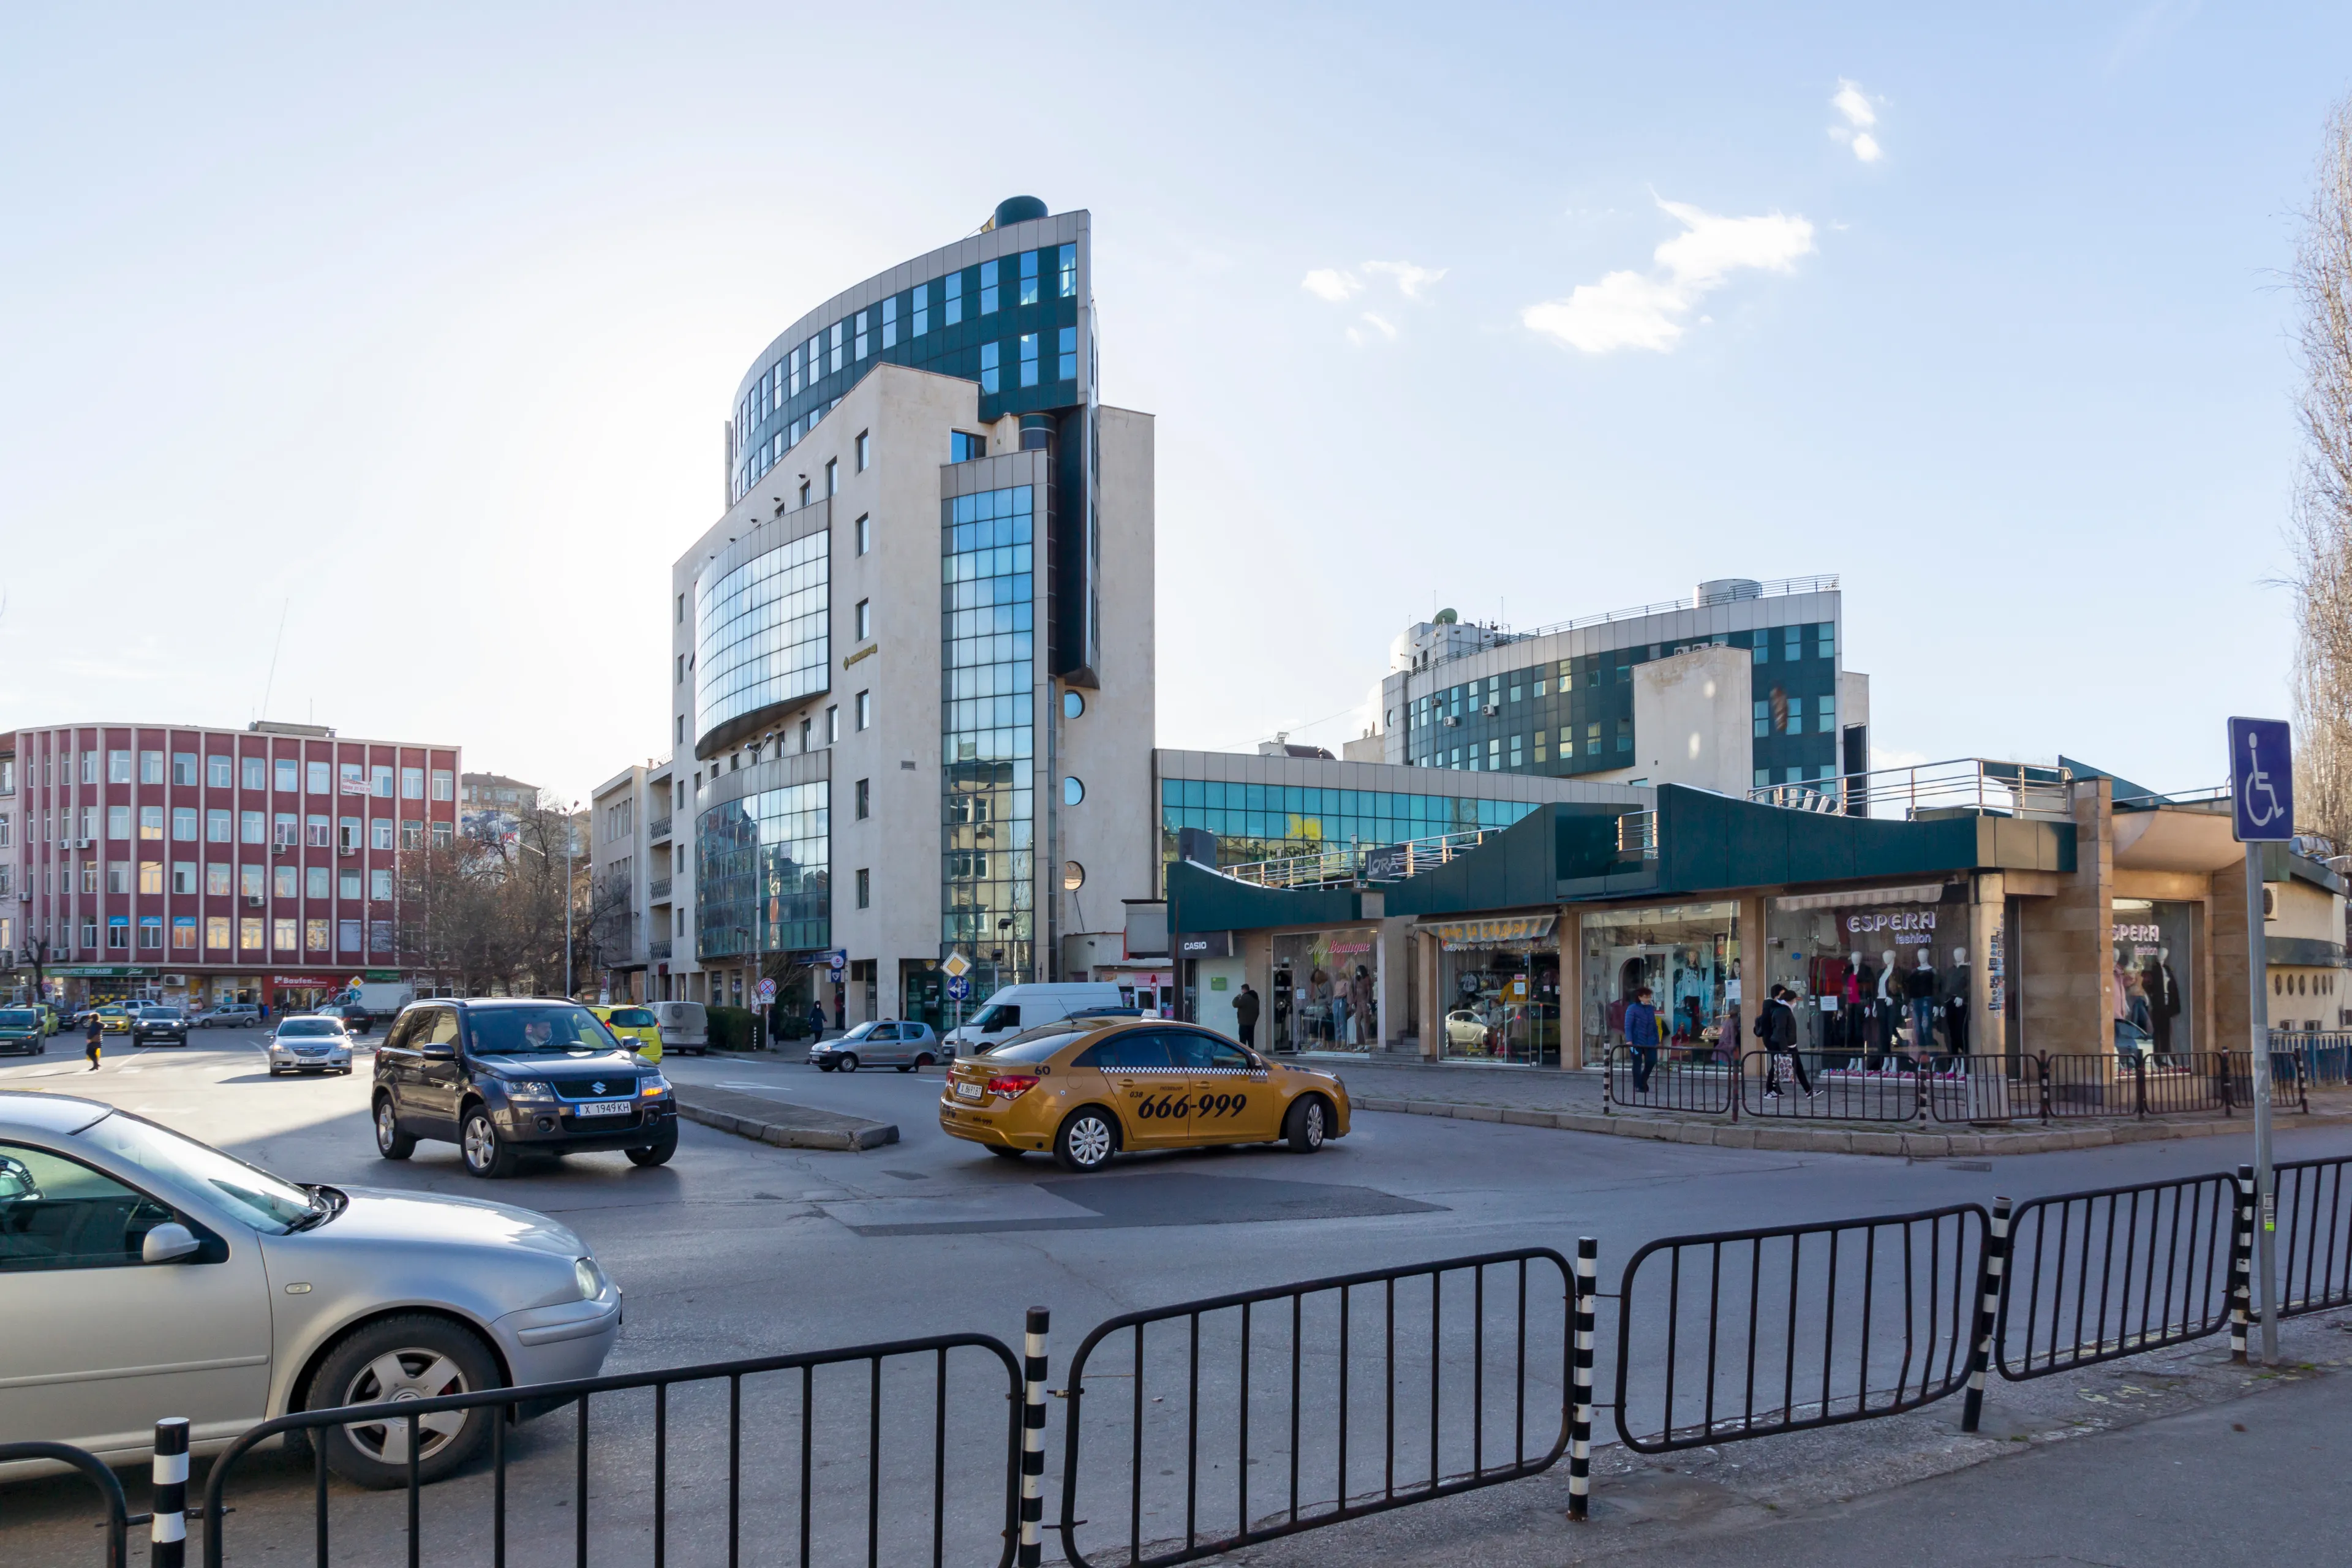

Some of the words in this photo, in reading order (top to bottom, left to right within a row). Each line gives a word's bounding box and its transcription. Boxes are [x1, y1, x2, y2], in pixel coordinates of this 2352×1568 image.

[1846, 911, 1936, 933] ESPERA
[1894, 932, 1931, 944] fashion
[2112, 924, 2160, 941] SPERA
[1184, 941, 1207, 951] CASIO
[1306, 939, 1329, 959] My
[1327, 940, 1371, 956] Boutique
[1035, 1066, 1051, 1076] 60
[584, 1105, 590, 1114] X
[596, 1102, 630, 1114] 1949KH
[1137, 1093, 1247, 1119] 666-999
